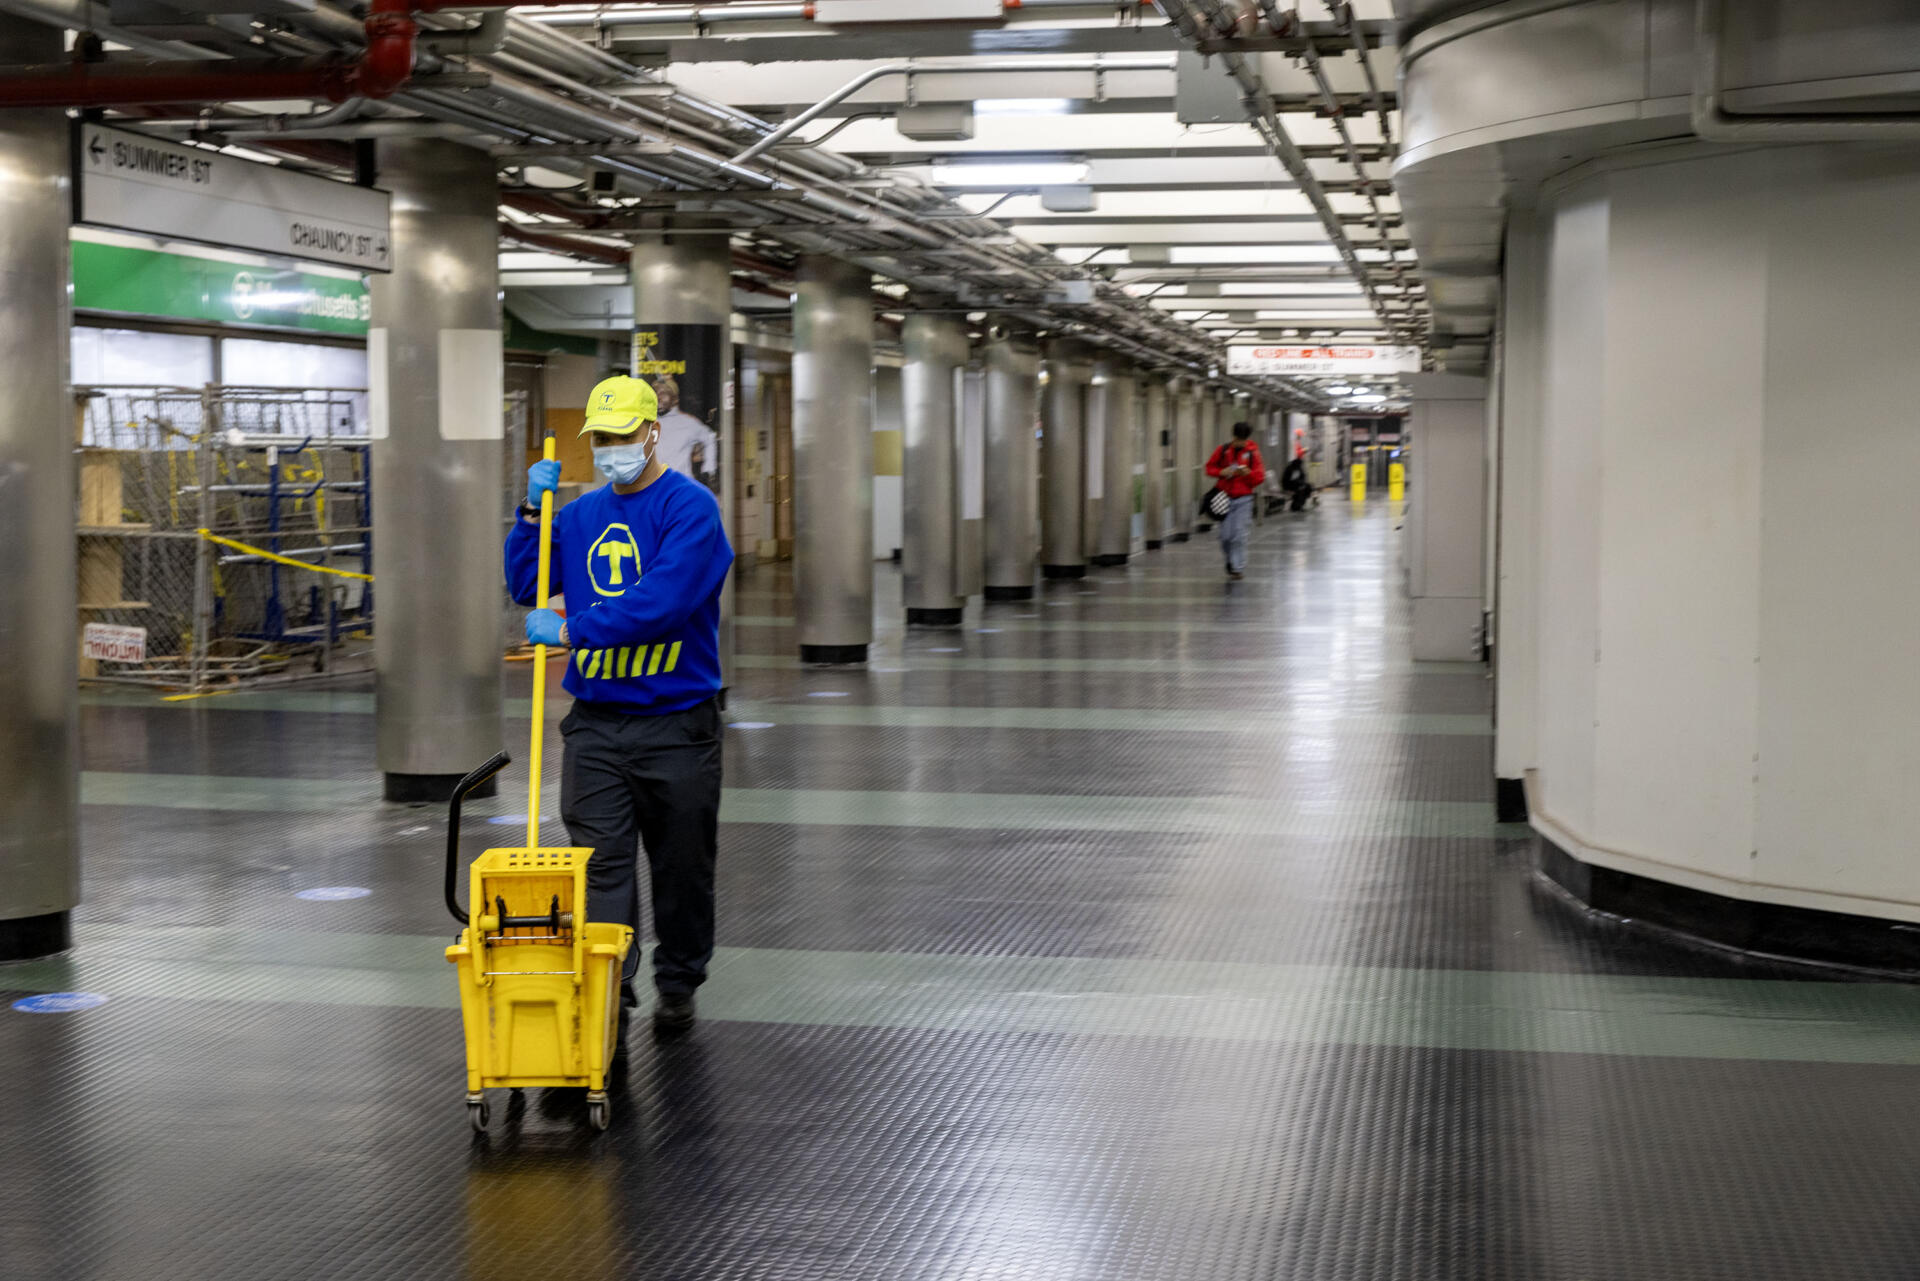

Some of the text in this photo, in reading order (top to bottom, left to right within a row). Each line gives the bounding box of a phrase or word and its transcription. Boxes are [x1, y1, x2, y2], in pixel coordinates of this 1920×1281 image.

[112, 142, 213, 184] SUMMER ST
[290, 222, 372, 256] CHAUNCY ST
[598, 540, 633, 584] T
